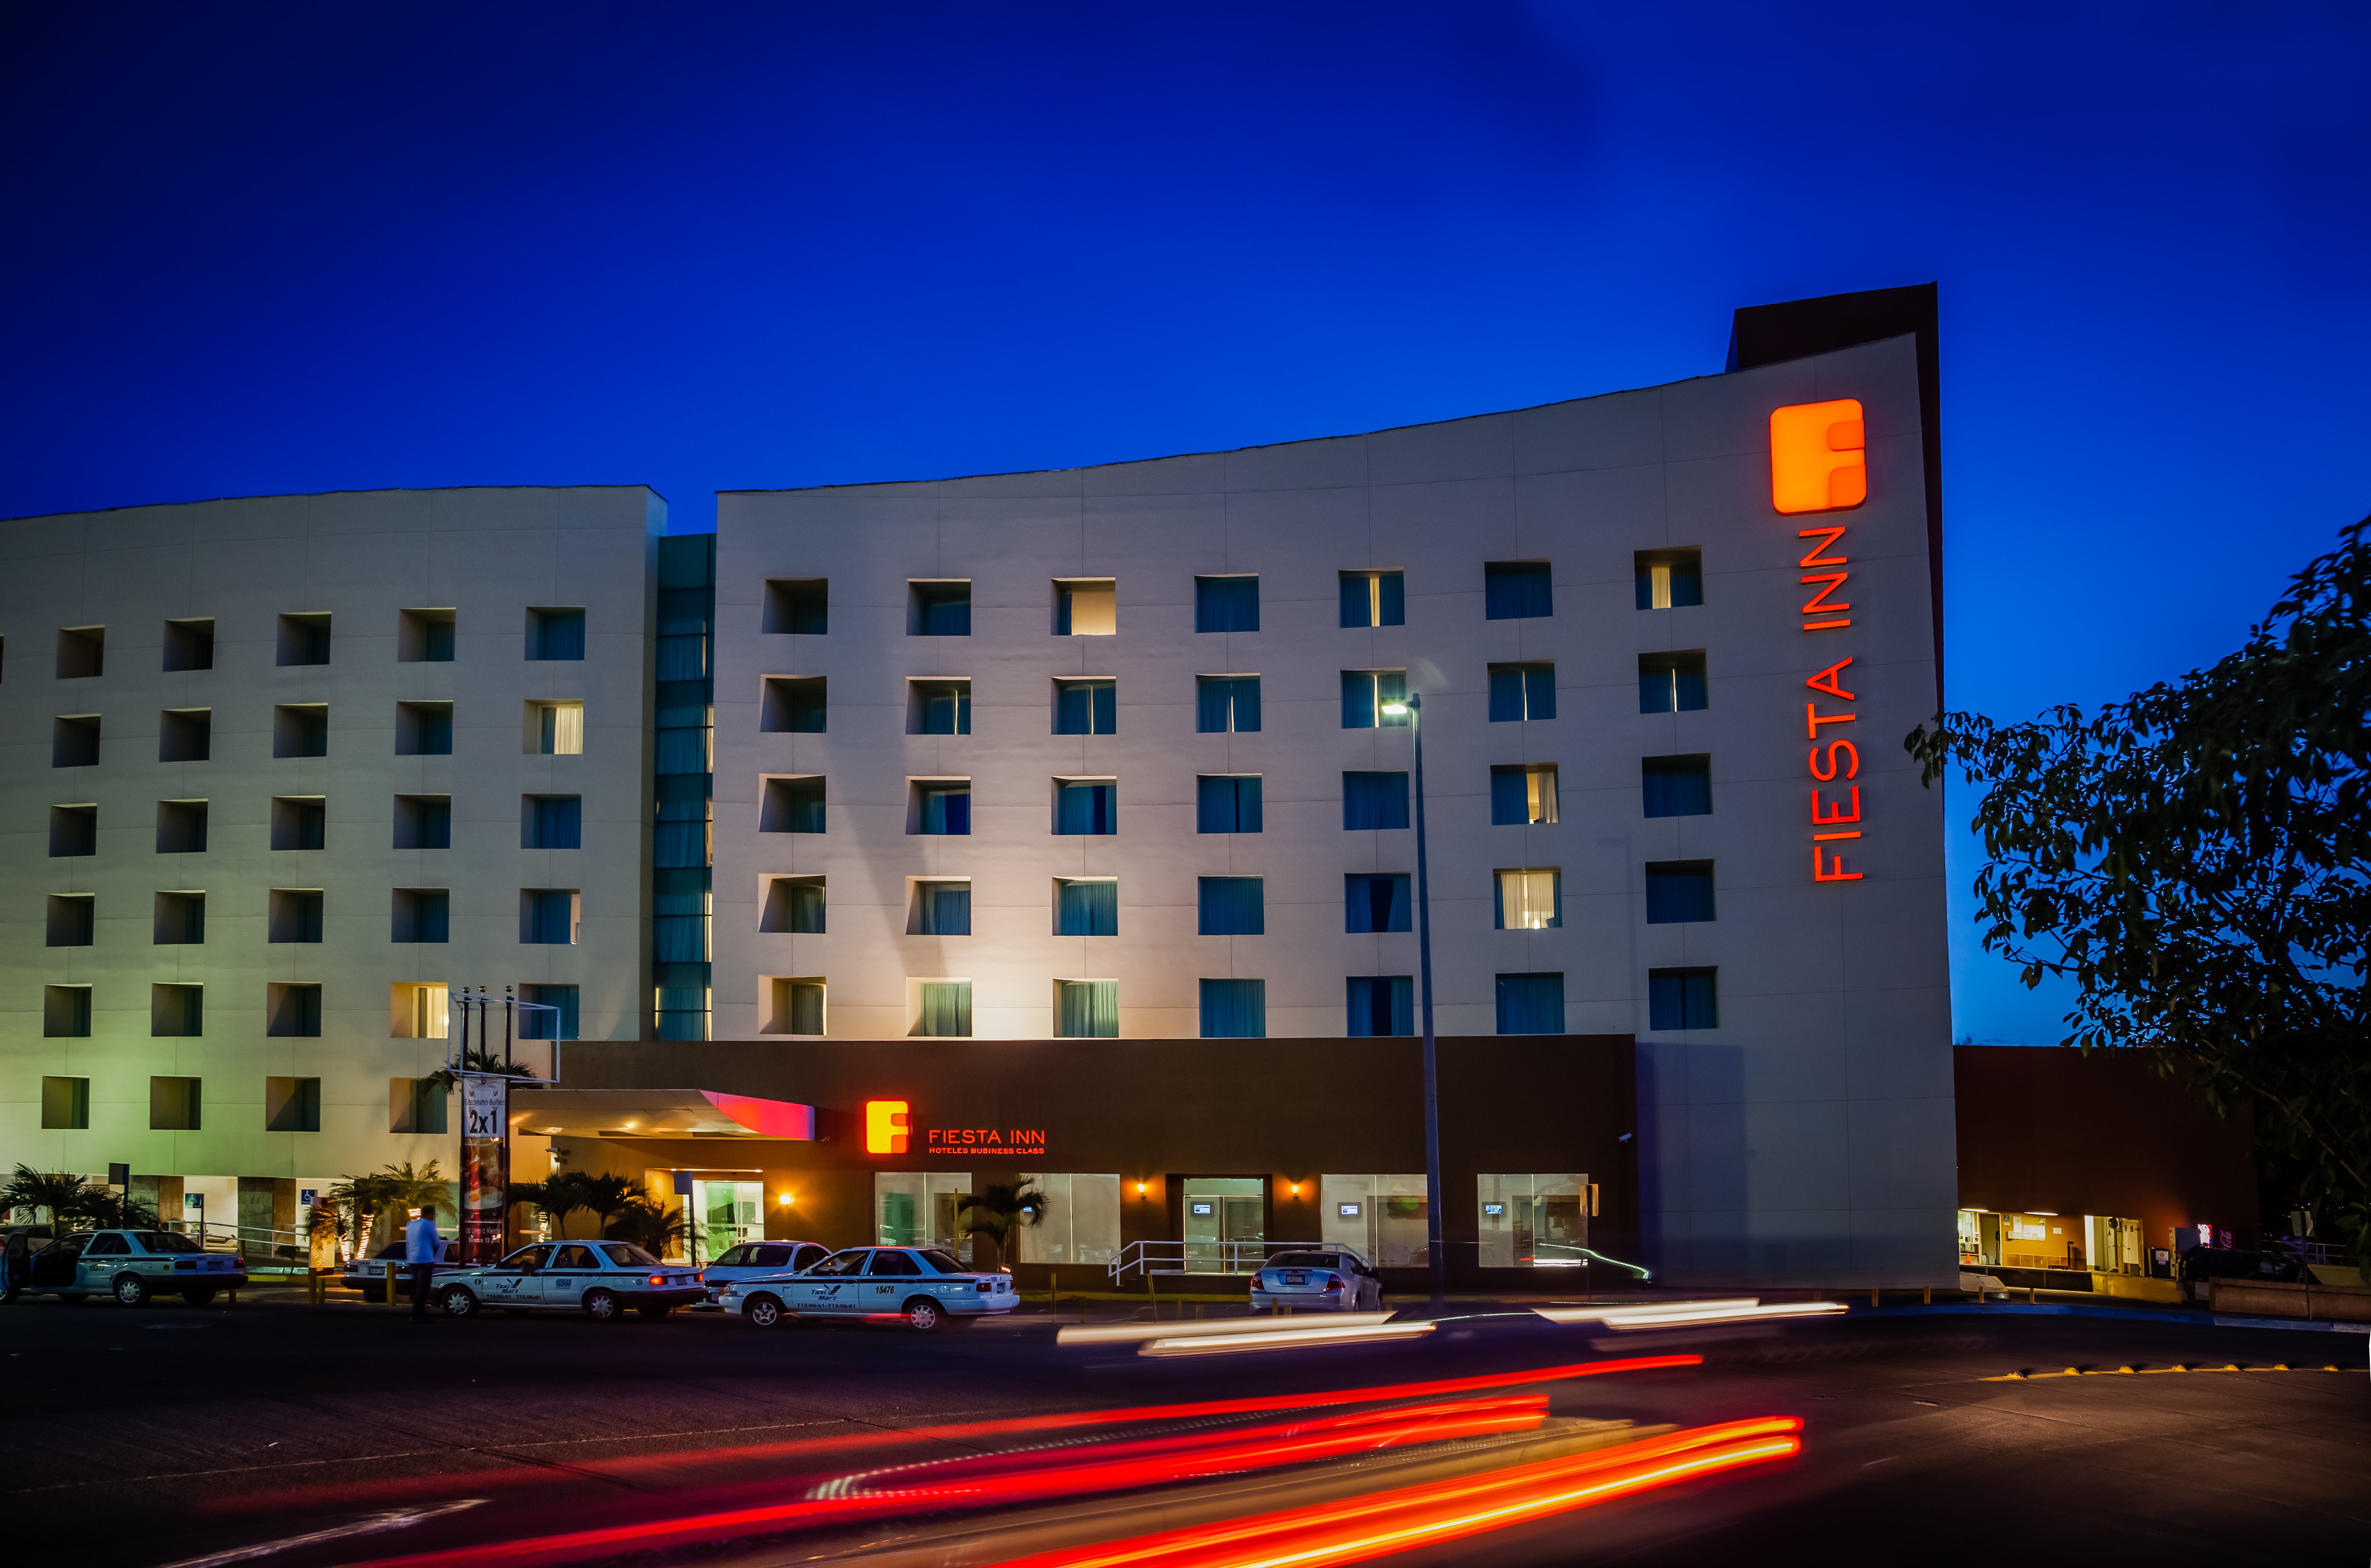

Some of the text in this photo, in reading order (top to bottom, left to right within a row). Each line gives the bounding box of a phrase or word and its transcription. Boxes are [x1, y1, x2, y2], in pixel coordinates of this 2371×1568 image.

[1798, 526, 1863, 882] FIESTA INN
[470, 1109, 497, 1134] 2x1
[929, 1129, 1045, 1144] FIESTA INN
[876, 1285, 895, 1294] 15476
